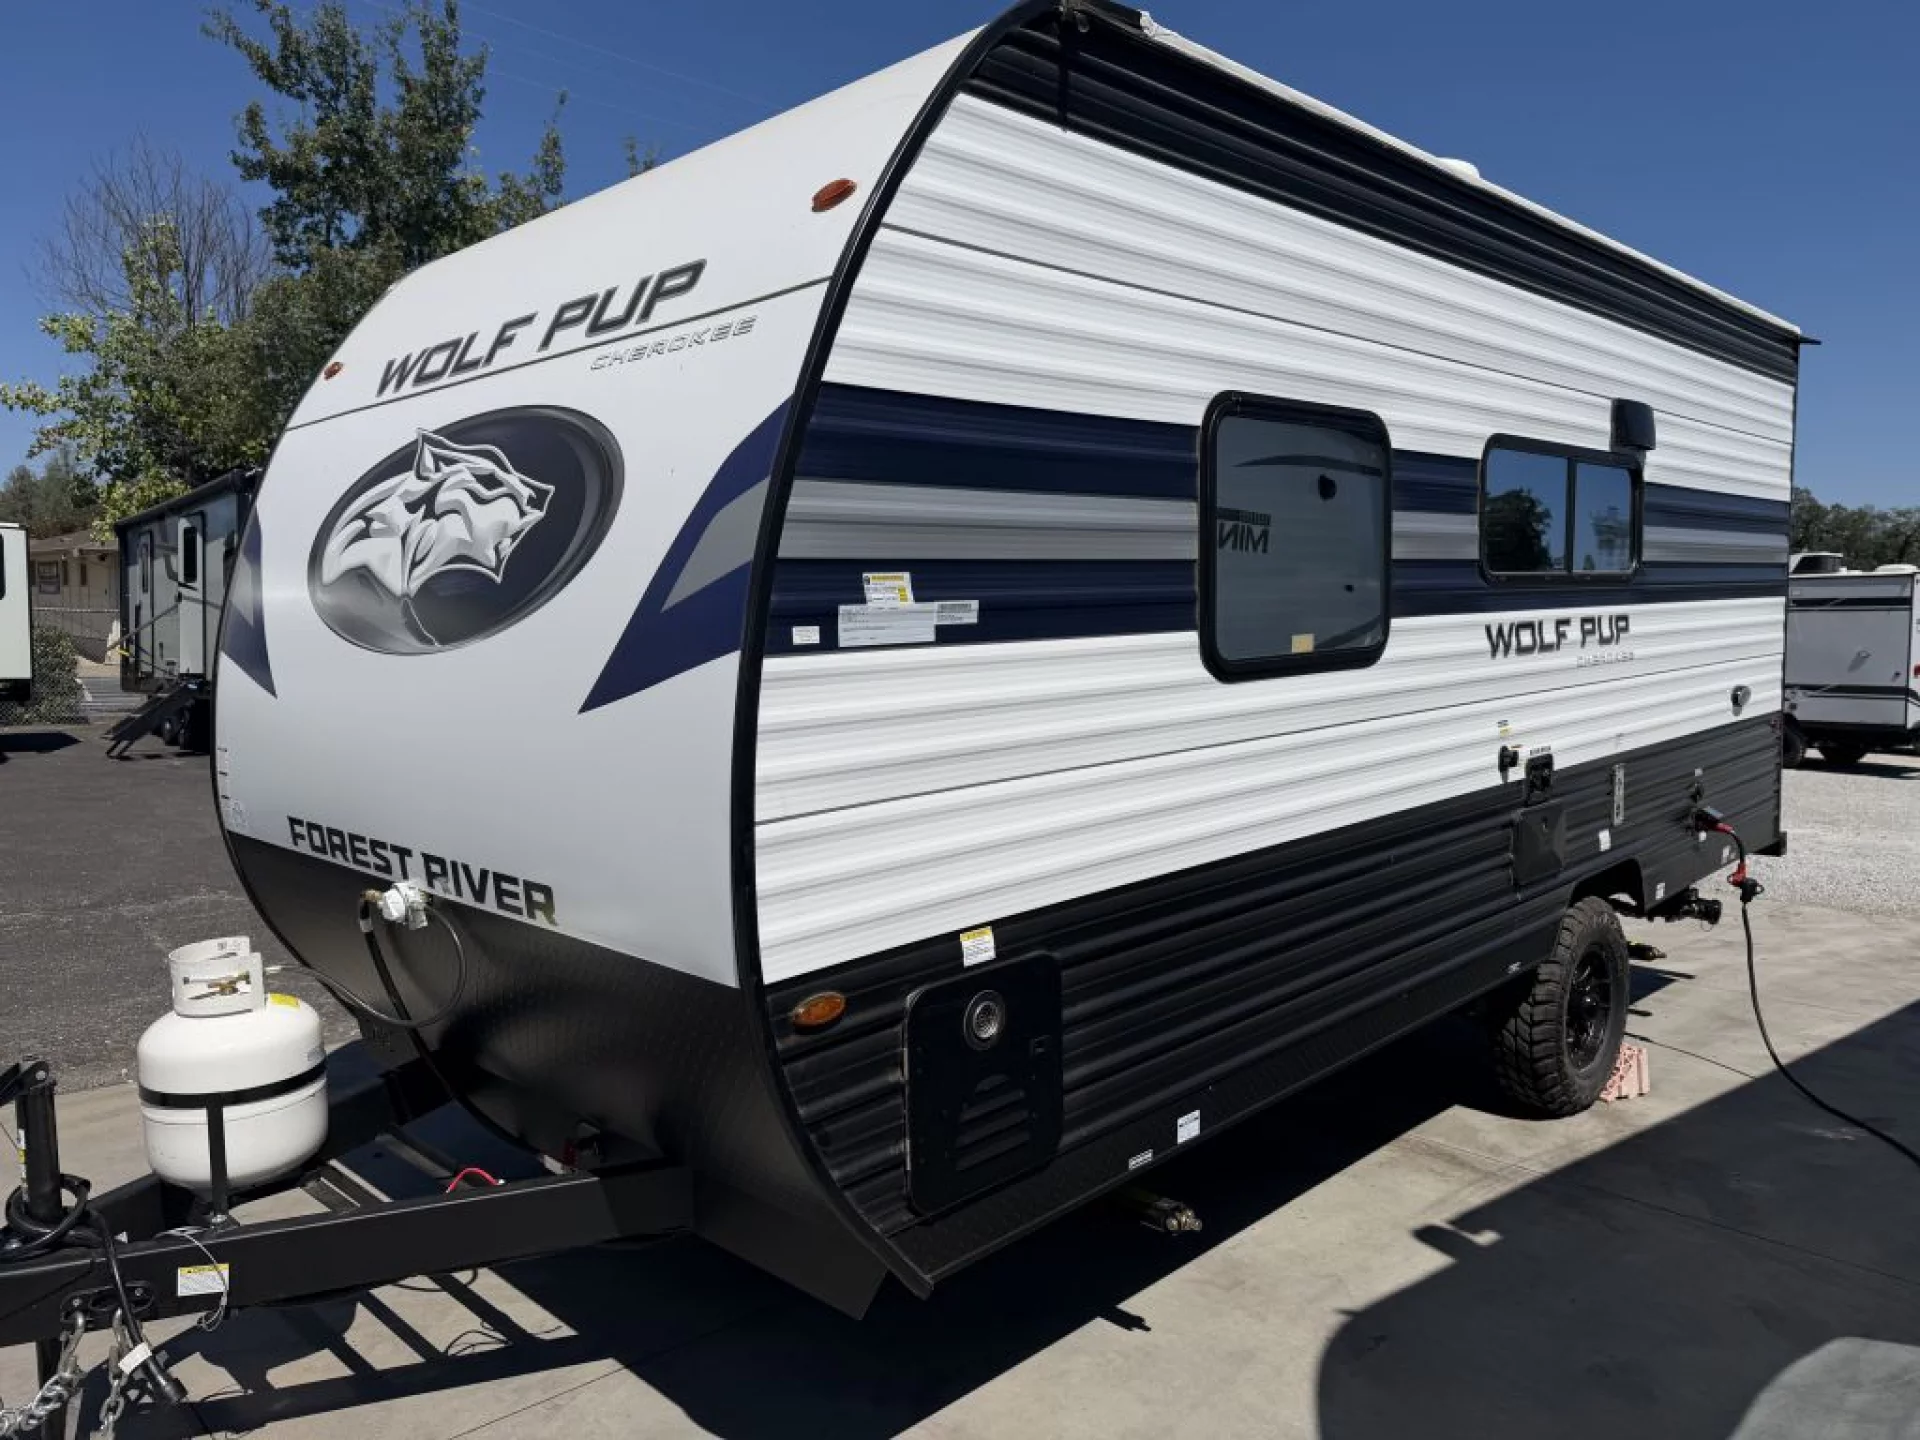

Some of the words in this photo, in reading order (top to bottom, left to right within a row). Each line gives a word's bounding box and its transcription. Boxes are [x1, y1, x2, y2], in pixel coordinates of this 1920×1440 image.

[376, 311, 539, 398] WOLF
[537, 258, 708, 353] PUP
[589, 314, 759, 372] CHEROKEE
[1484, 616, 1572, 660] WOLF
[1580, 614, 1630, 649] PUP
[286, 814, 413, 881] FOREST
[420, 851, 558, 927] RIVER
